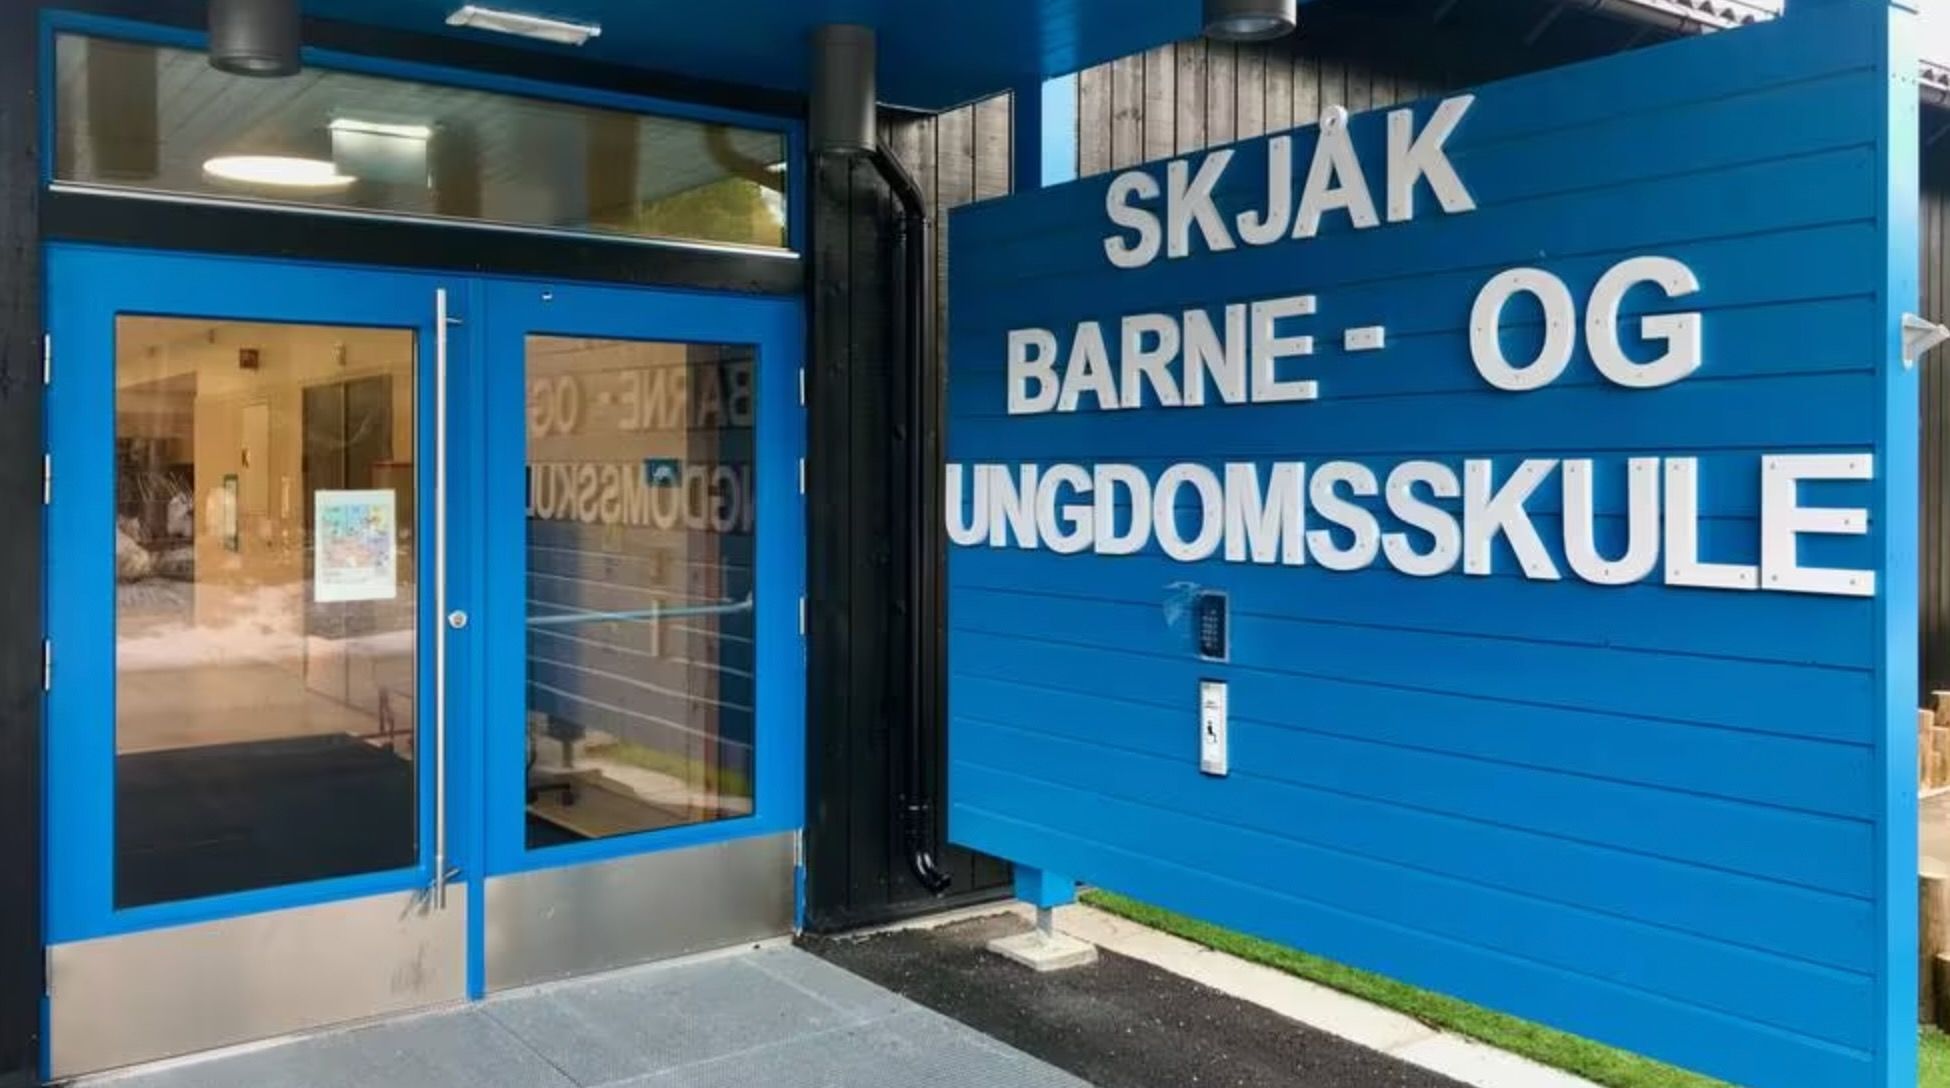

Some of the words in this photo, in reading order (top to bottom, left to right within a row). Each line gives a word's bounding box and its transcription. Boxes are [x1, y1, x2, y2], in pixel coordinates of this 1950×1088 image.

[1103, 94, 1476, 269] SKJÅK
[1469, 255, 1702, 392] OG
[944, 452, 1876, 596] UNGDOMSSKULE
